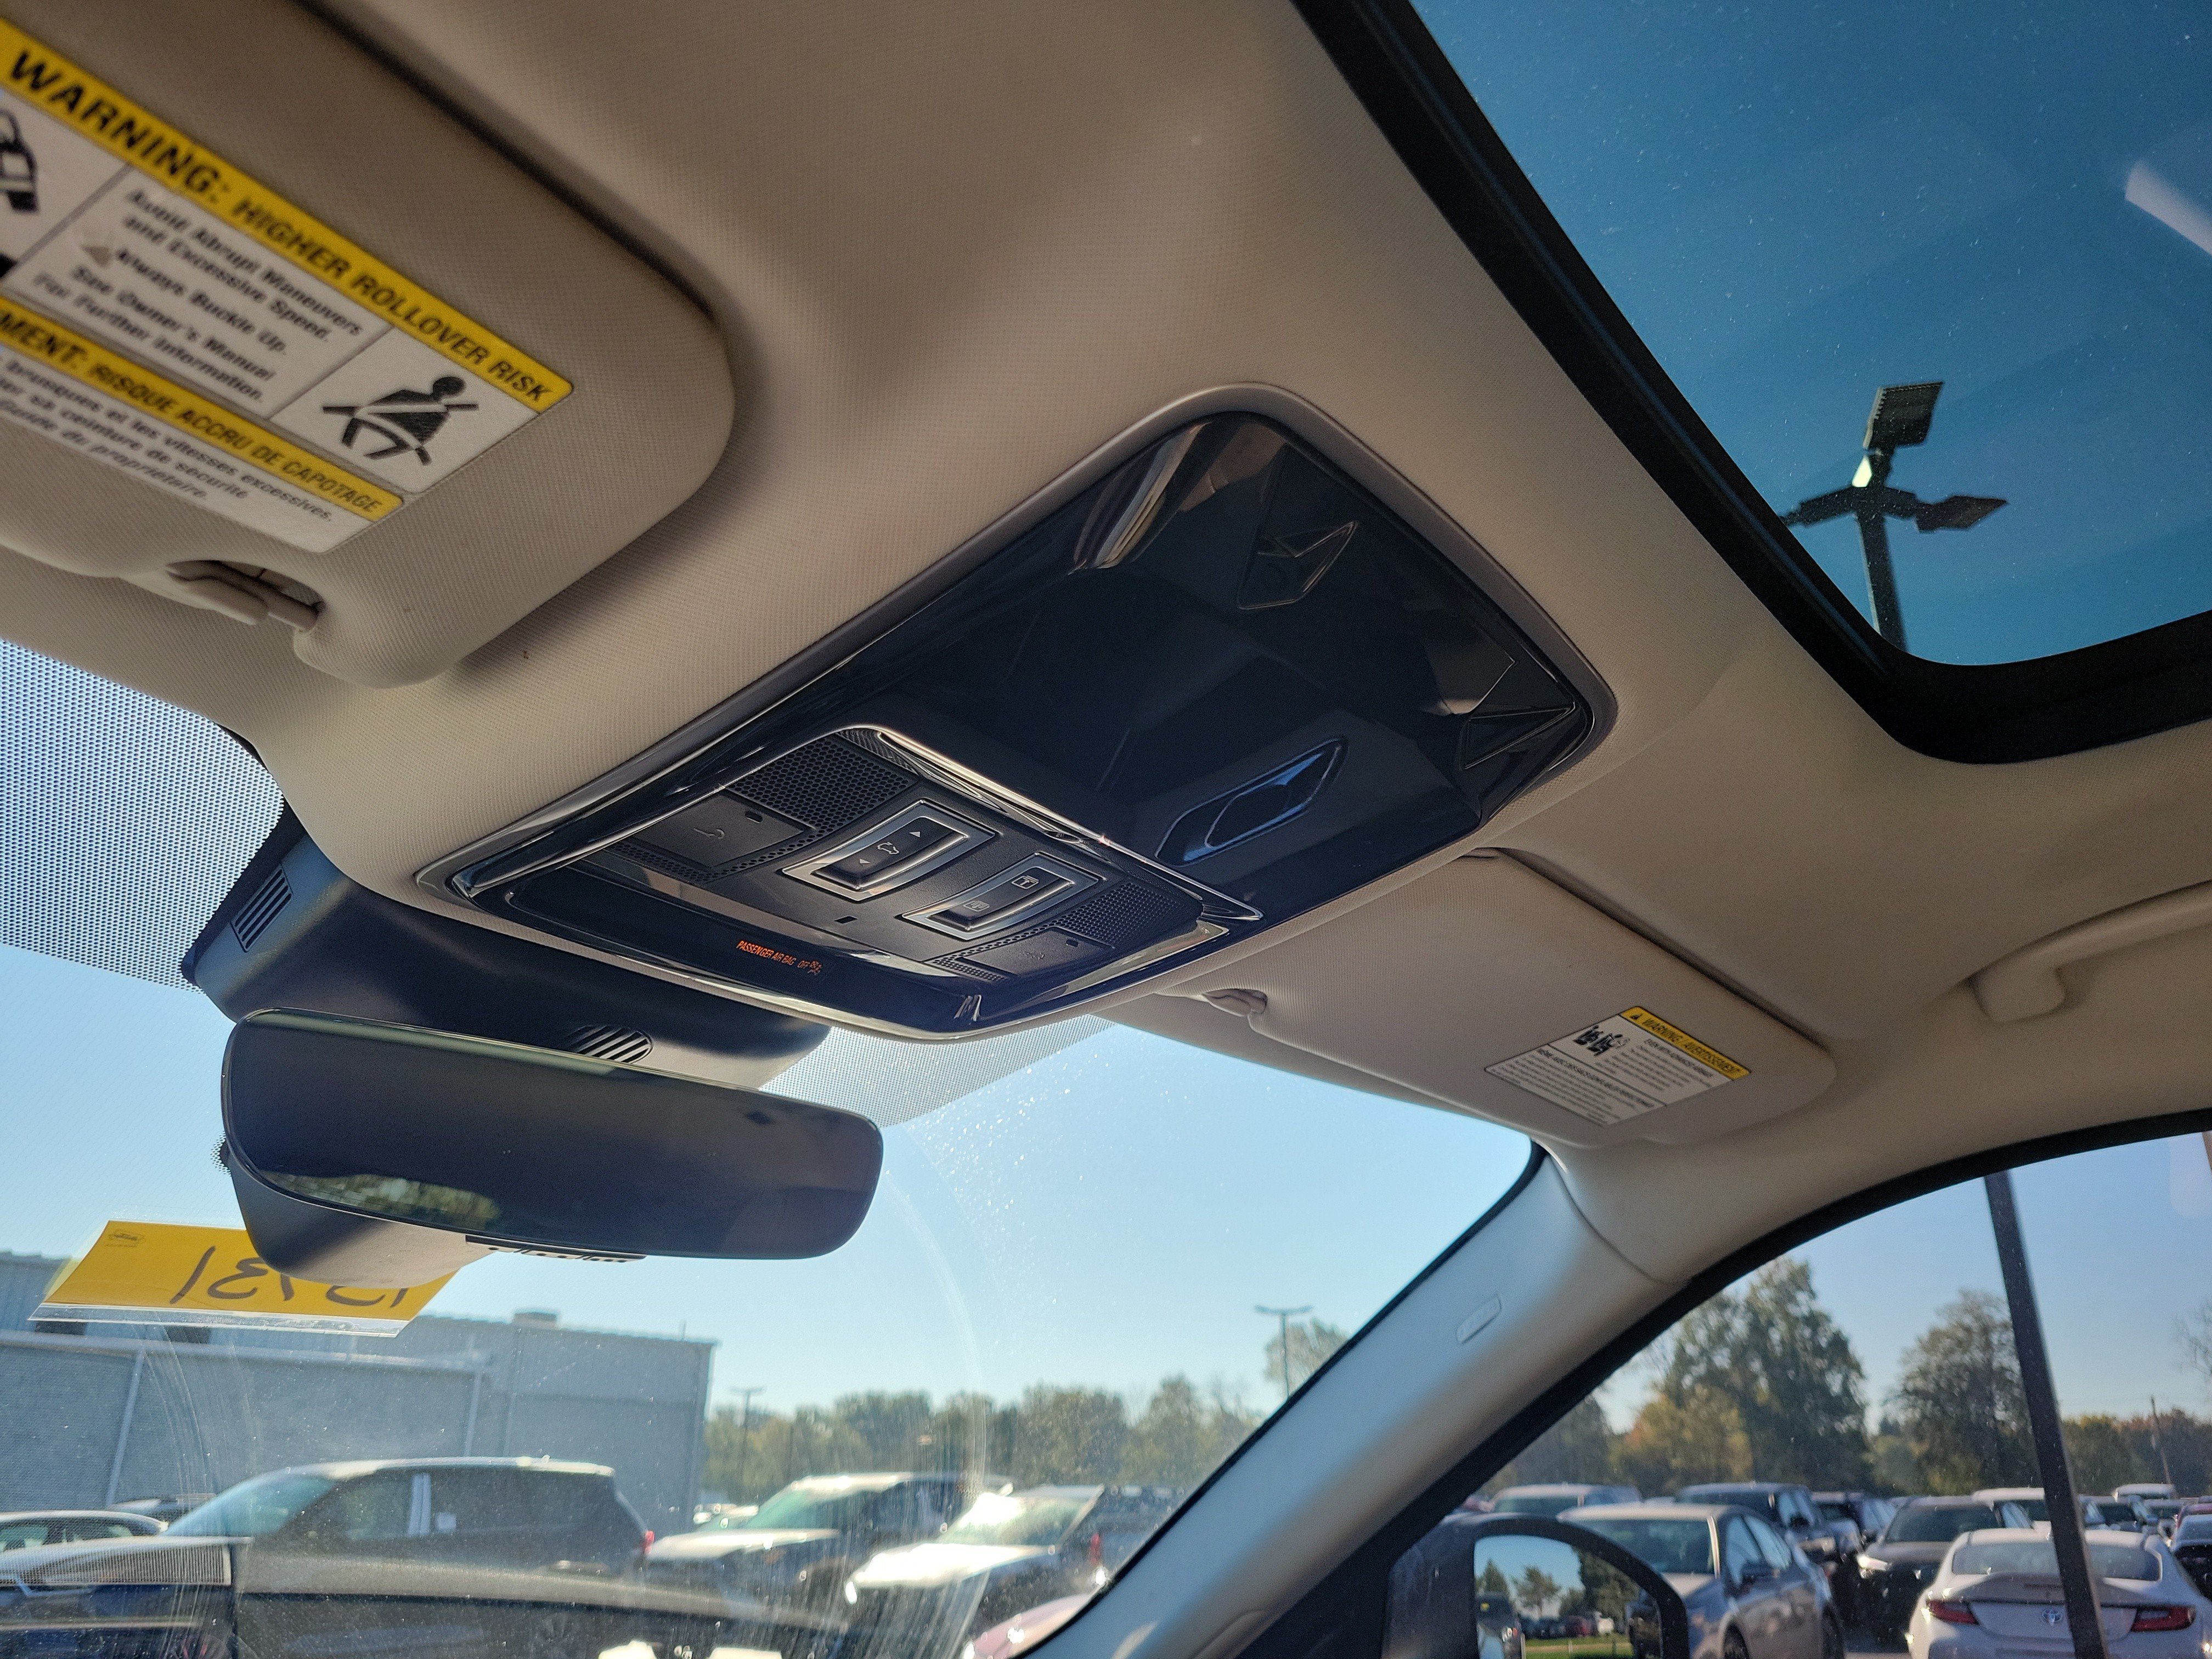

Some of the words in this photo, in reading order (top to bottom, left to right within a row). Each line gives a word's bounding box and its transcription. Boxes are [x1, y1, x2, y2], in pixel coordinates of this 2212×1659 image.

[10, 50, 230, 203] WARNING:
[231, 198, 352, 279] HIGHER
[352, 271, 493, 365] ROLLOVER
[488, 360, 553, 403] RISK
[168, 239, 268, 302] Excessive
[269, 298, 331, 342] Speed.
[189, 289, 255, 334] Buckle
[262, 267, 363, 336] Maneuvers
[152, 335, 263, 403] Information.
[202, 334, 276, 381] Manual
[87, 363, 178, 411] RISQUE
[175, 408, 254, 450] ACCRU
[251, 444, 285, 467] DE
[281, 460, 382, 512] CAPOTAGE
[163, 437, 239, 476] vitesses
[240, 473, 332, 522] excessives.
[736, 940, 774, 958] PASSENGER
[771, 952, 785, 962] AIR
[781, 955, 797, 966] BAG
